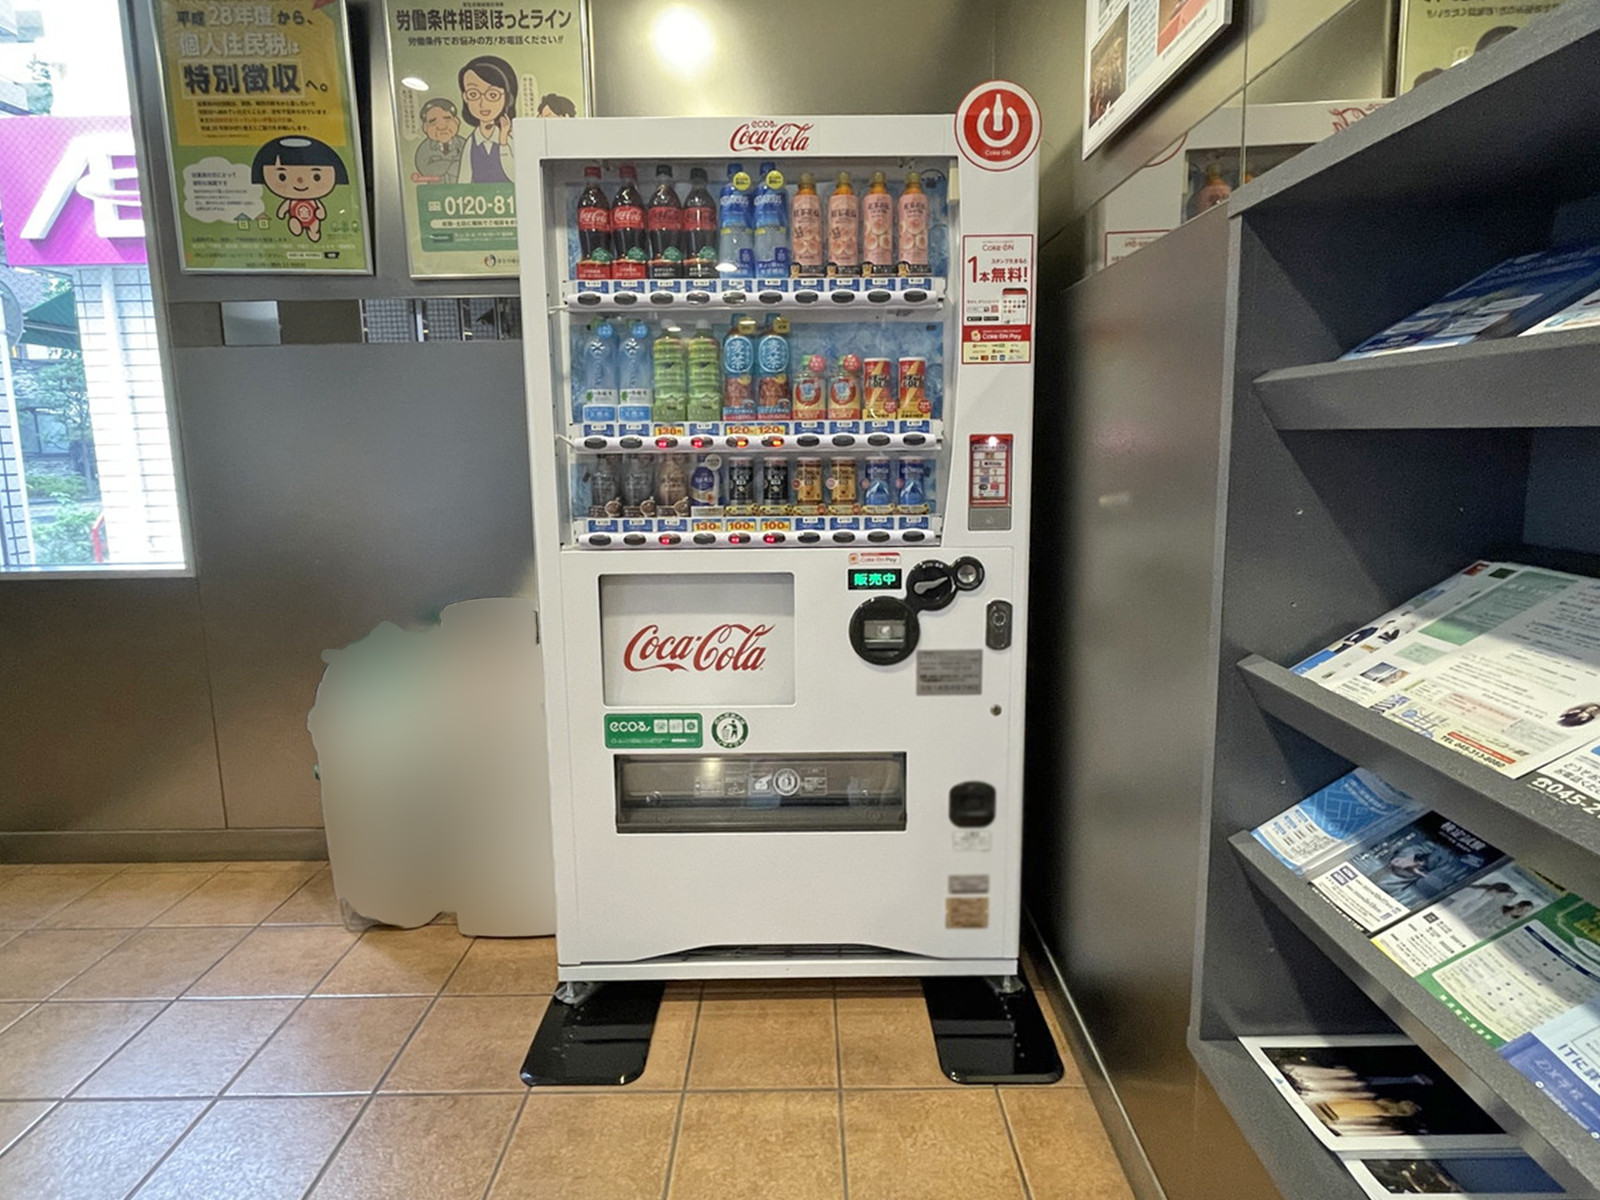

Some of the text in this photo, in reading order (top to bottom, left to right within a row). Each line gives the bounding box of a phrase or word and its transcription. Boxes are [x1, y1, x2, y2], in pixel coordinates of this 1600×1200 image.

[396, 9, 572, 32] 労働条件相談ほっとライン
[729, 123, 815, 152] Coca-Cola
[854, 572, 896, 586] 販売中
[623, 623, 776, 673] Coca-Cola
